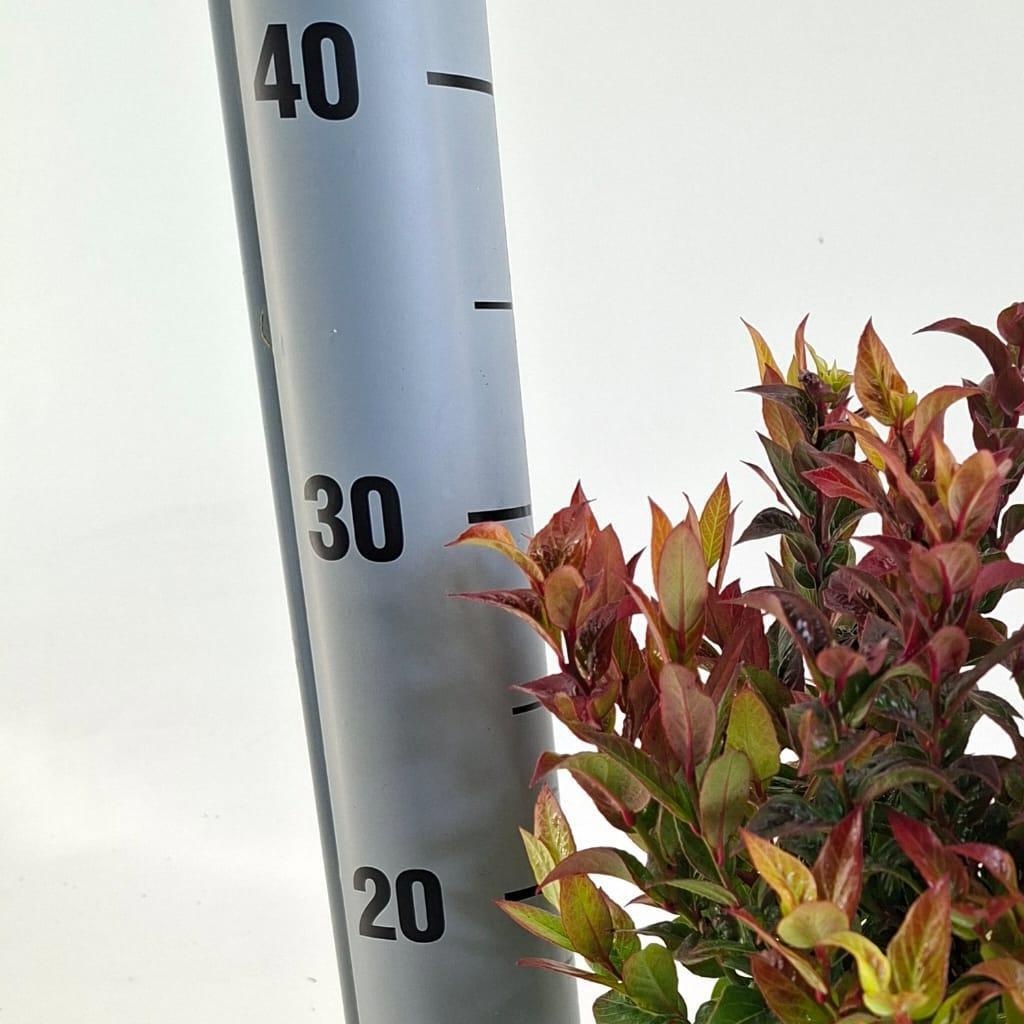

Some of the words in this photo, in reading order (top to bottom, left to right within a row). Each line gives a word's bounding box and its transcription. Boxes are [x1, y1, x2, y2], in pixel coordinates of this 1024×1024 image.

[254, 21, 360, 121] 40
[304, 474, 404, 563] 30
[352, 866, 446, 944] 20
